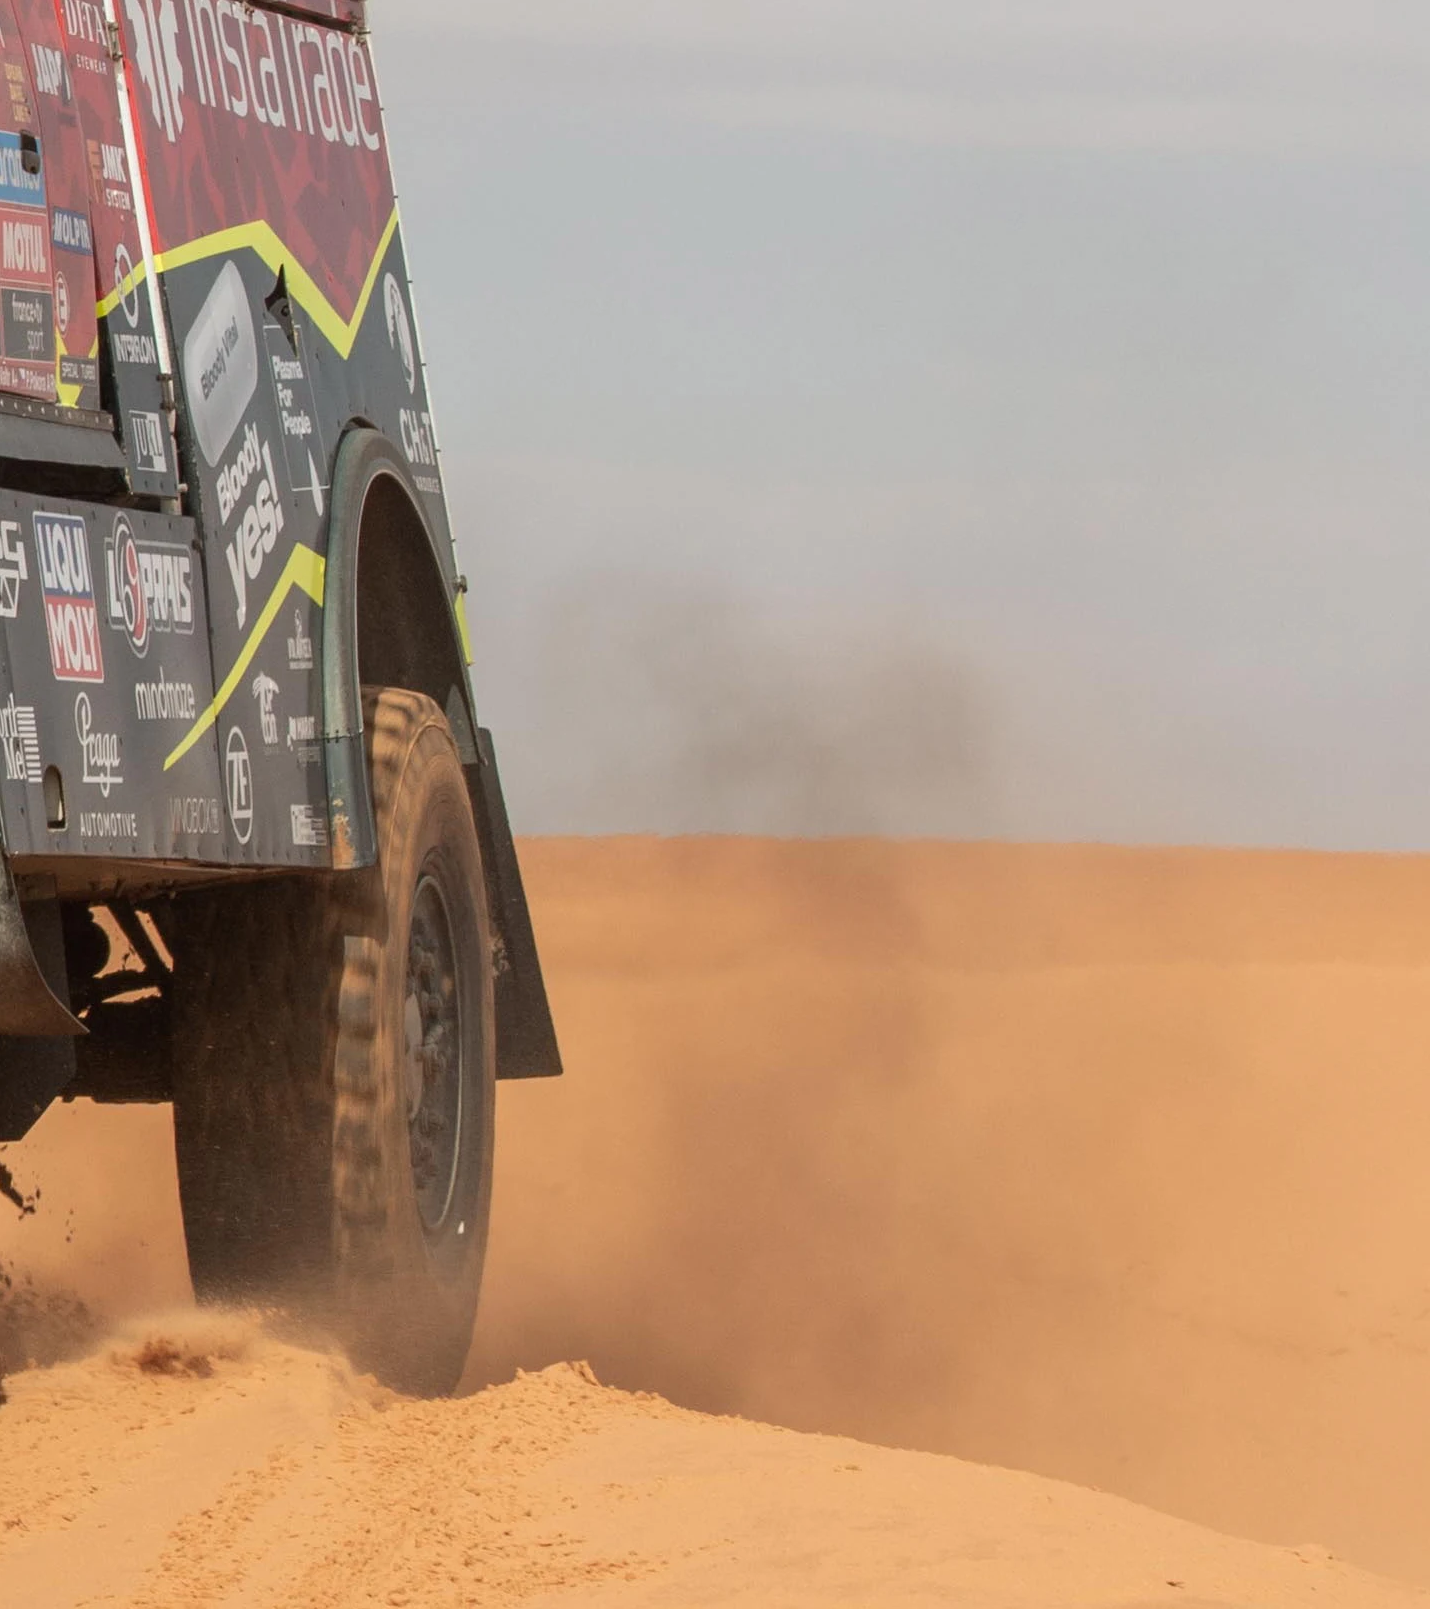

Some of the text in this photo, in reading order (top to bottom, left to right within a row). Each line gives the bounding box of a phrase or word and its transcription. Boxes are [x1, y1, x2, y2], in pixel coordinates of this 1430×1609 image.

[76, 53, 107, 75] EYEWEAR
[2, 220, 46, 273] MOTUL
[272, 355, 303, 380] Plasma
[277, 383, 293, 407] For
[281, 410, 311, 440] People
[216, 421, 261, 527] Bloody
[37, 522, 90, 594] LIQUI
[226, 439, 284, 631] yes!
[48, 602, 97, 672] MOLY
[135, 665, 195, 720] mindmaze
[75, 691, 123, 798] Praga
[229, 751, 252, 819] ZF
[80, 811, 137, 837] AUTOMOTIVE
